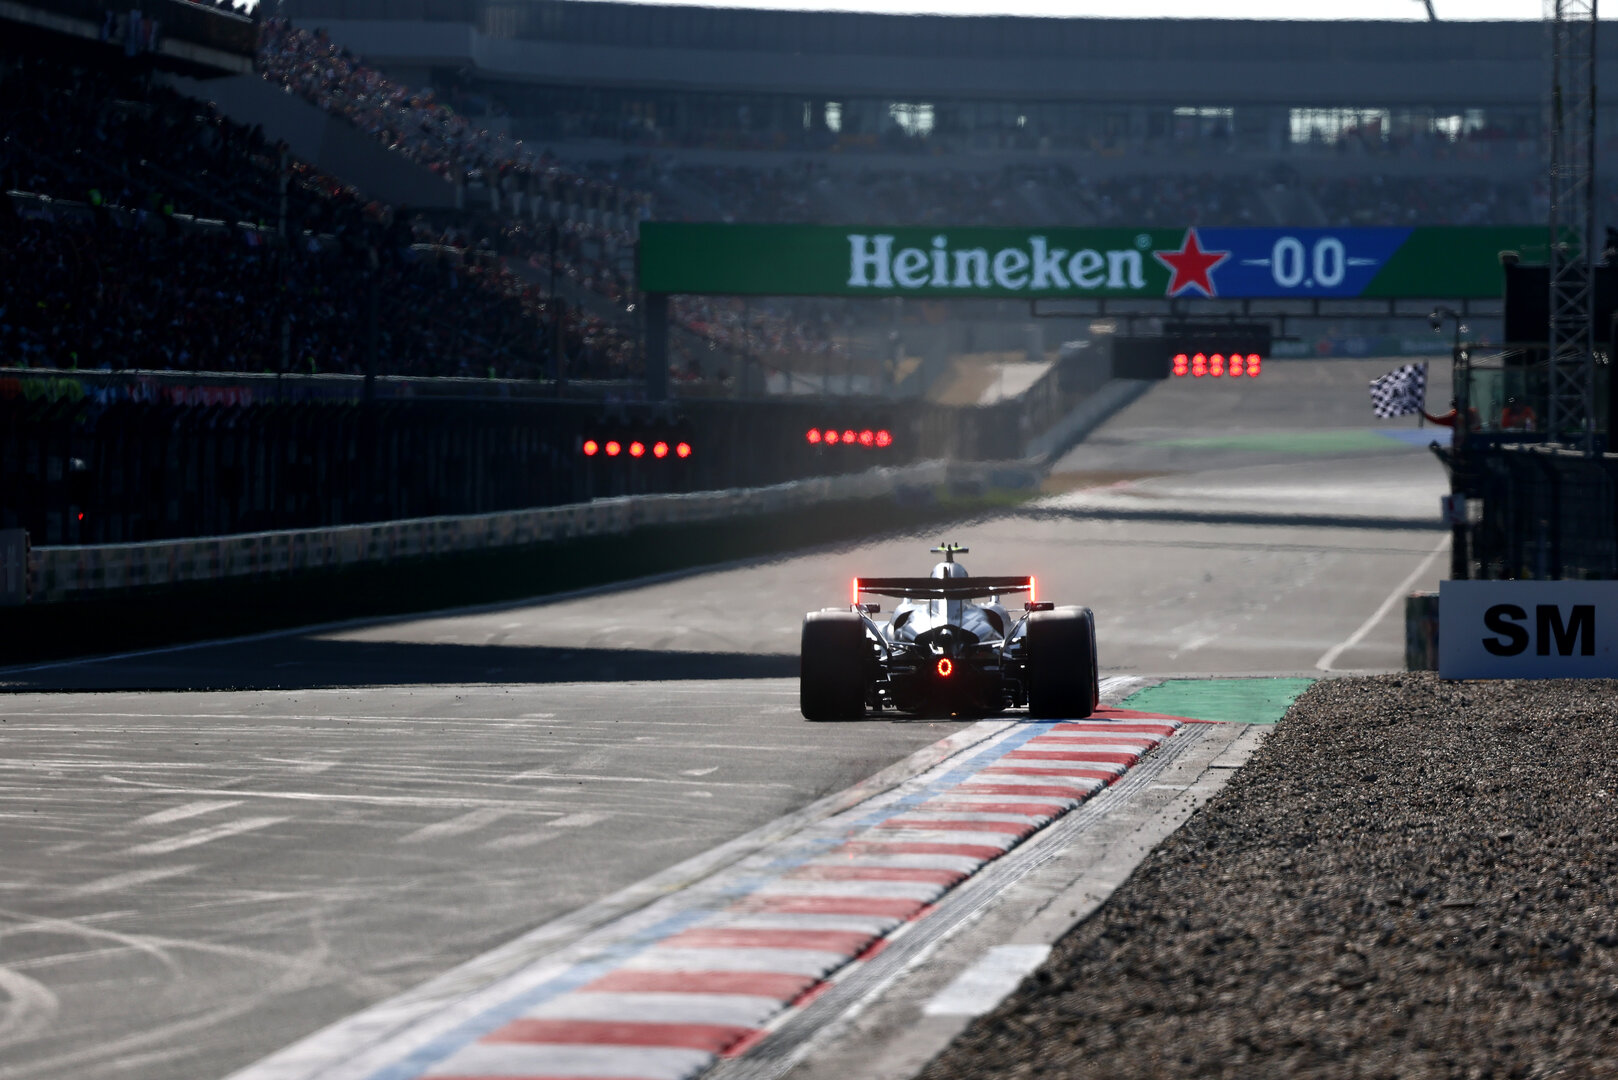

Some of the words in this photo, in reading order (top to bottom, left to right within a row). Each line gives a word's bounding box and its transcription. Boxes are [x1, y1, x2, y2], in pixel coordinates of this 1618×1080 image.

[847, 234, 1146, 288] Heineken
[1272, 236, 1345, 287] 0.0
[1482, 604, 1595, 656] SM
